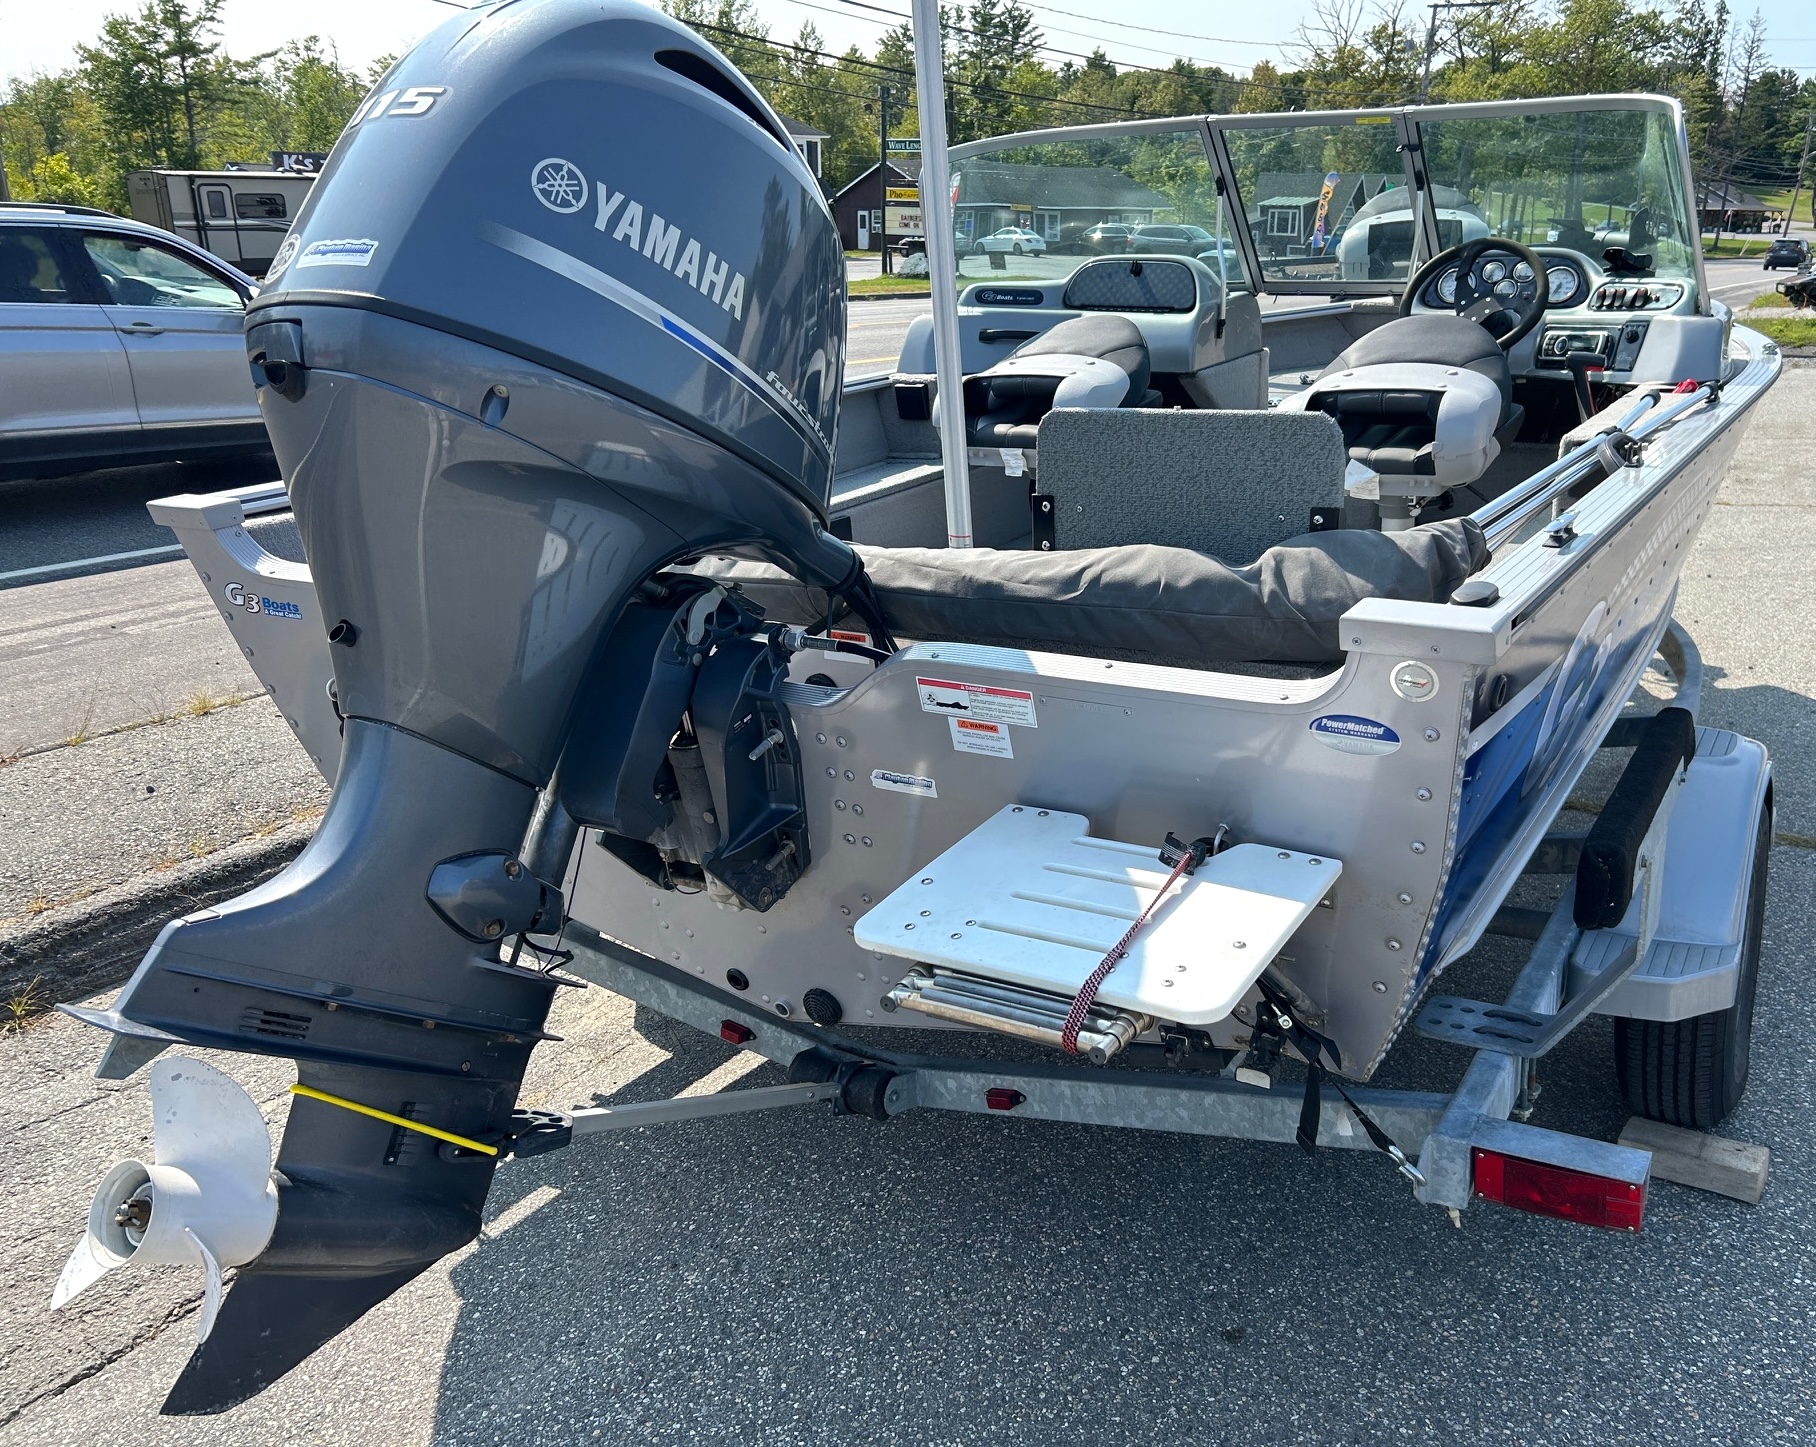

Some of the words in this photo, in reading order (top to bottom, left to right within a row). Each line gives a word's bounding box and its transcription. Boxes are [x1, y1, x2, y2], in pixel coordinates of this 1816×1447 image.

[349, 86, 446, 129] 115
[594, 180, 746, 321] YAMAHA
[224, 582, 261, 613] G3
[261, 597, 299, 612] Boats
[969, 722, 998, 732] WARNING
[1321, 718, 1385, 735] PowerMatched
